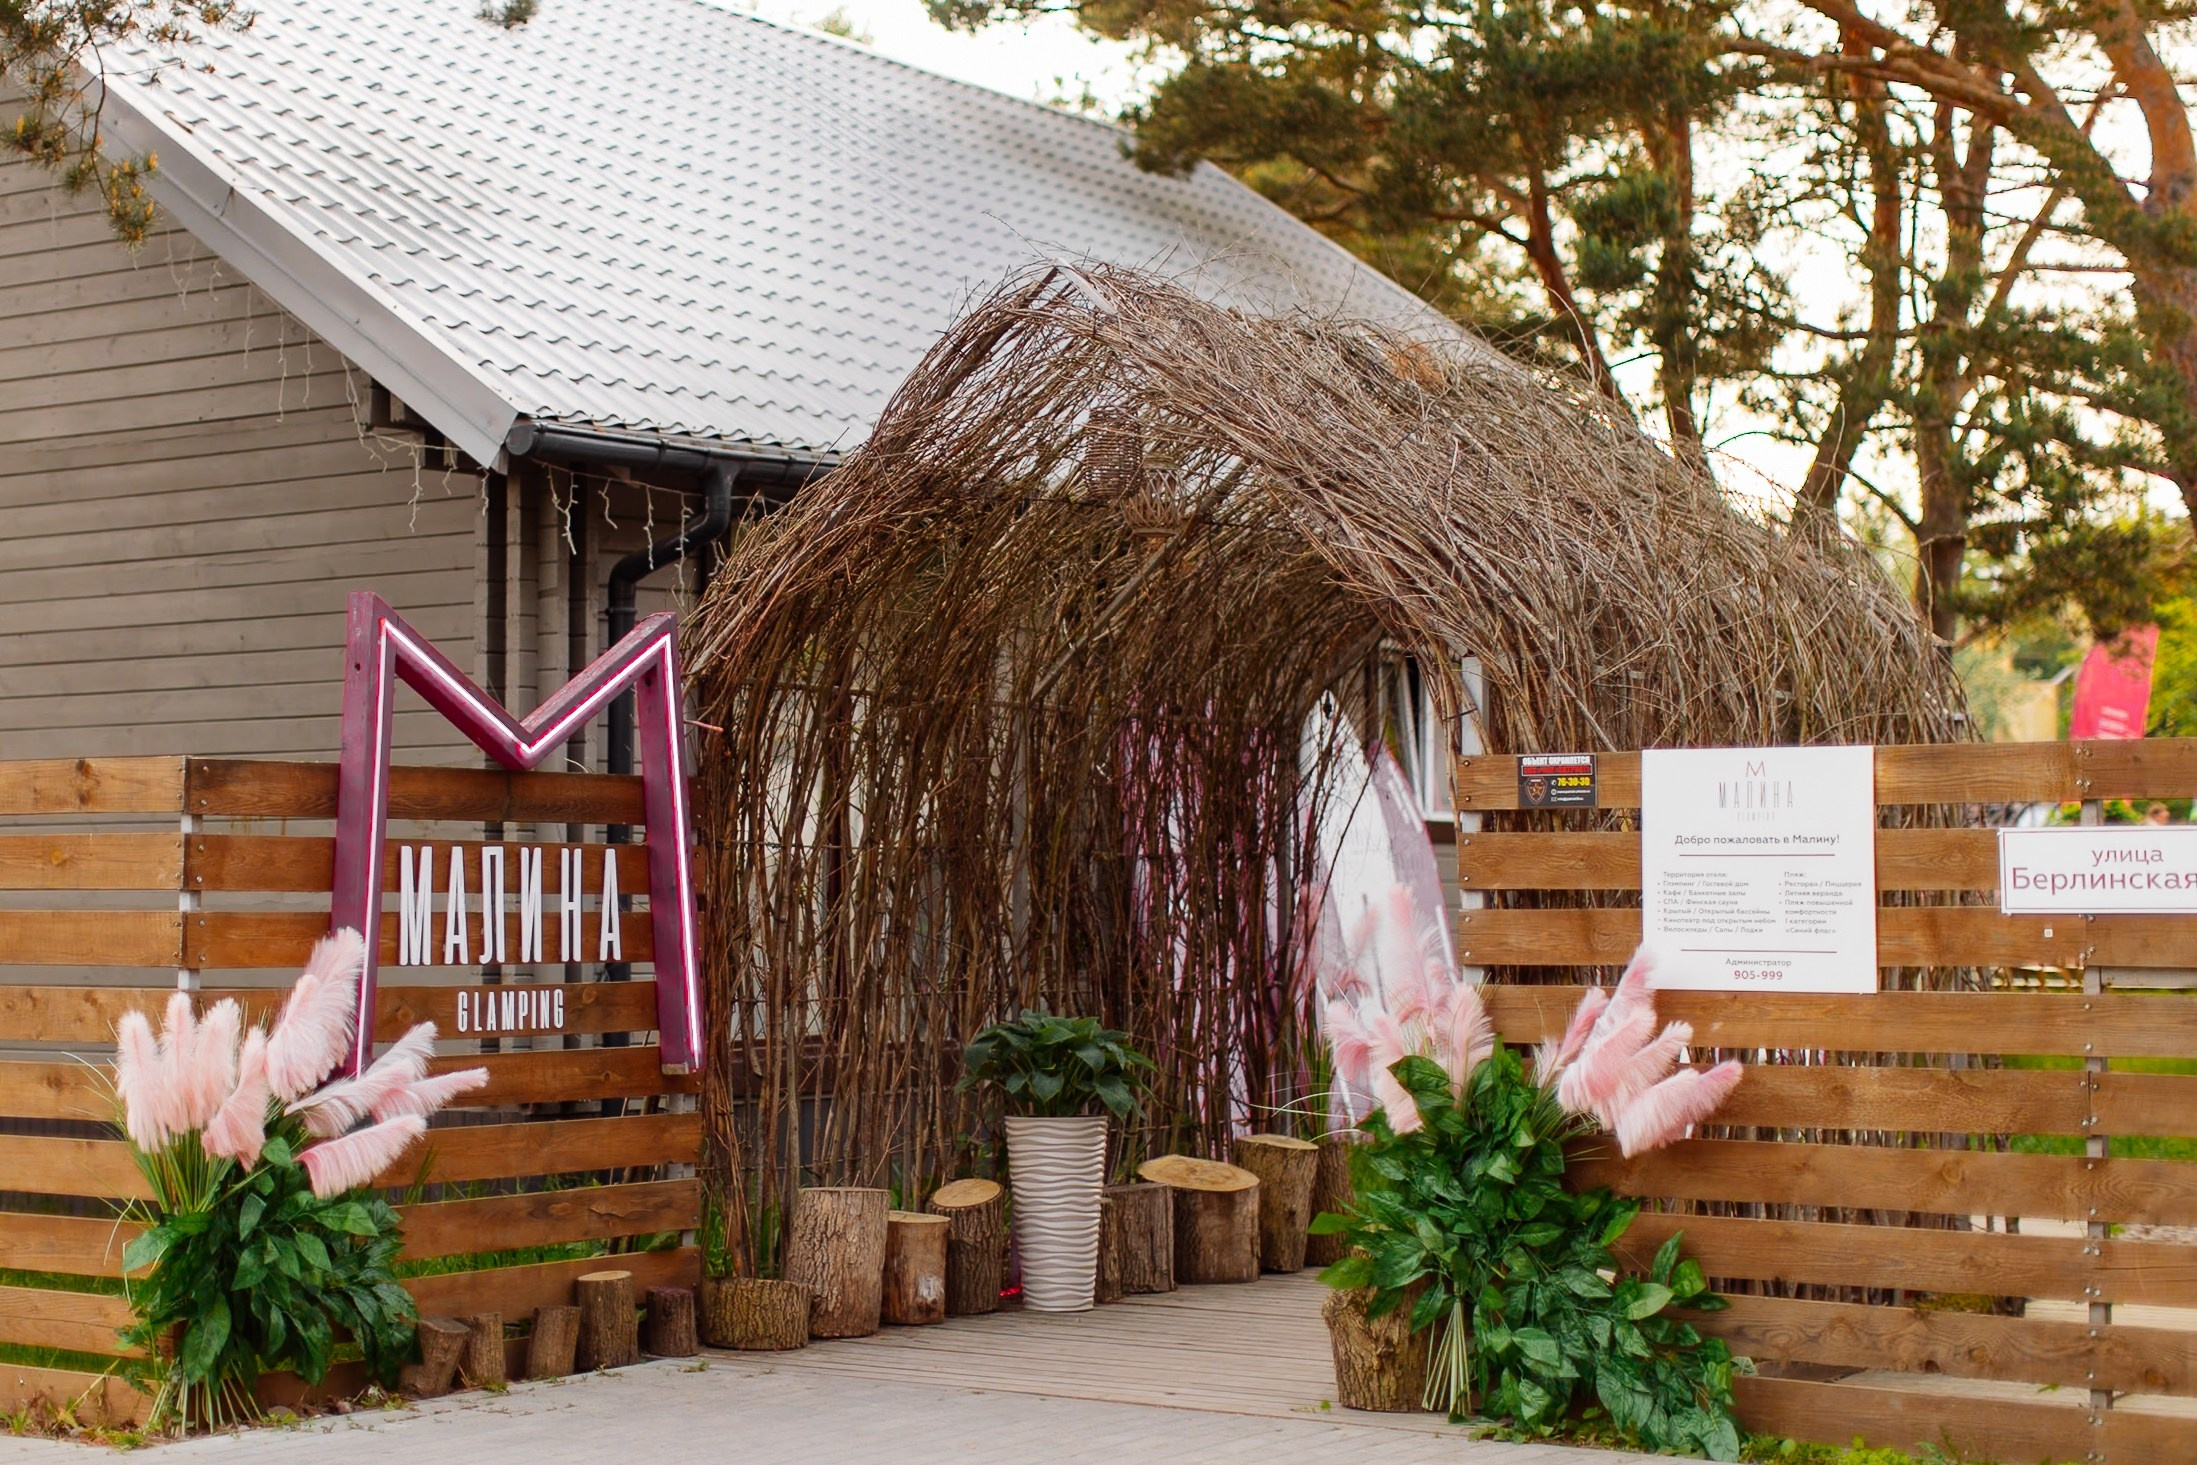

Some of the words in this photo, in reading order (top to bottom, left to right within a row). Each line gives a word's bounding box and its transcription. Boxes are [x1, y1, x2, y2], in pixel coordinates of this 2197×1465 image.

[1719, 780, 1793, 809] МАЛИНА
[1674, 835, 1711, 846] Добро
[1713, 836, 1780, 844] пожаловать
[1792, 834, 1840, 846] Малину!
[2091, 848, 2164, 867] улица
[2012, 867, 2197, 895] Берлинская
[399, 845, 622, 967] МАЛИНА
[1725, 958, 1792, 967] Администратор
[1734, 970, 1783, 980] 905-999
[457, 988, 565, 1033] GLAMPING
